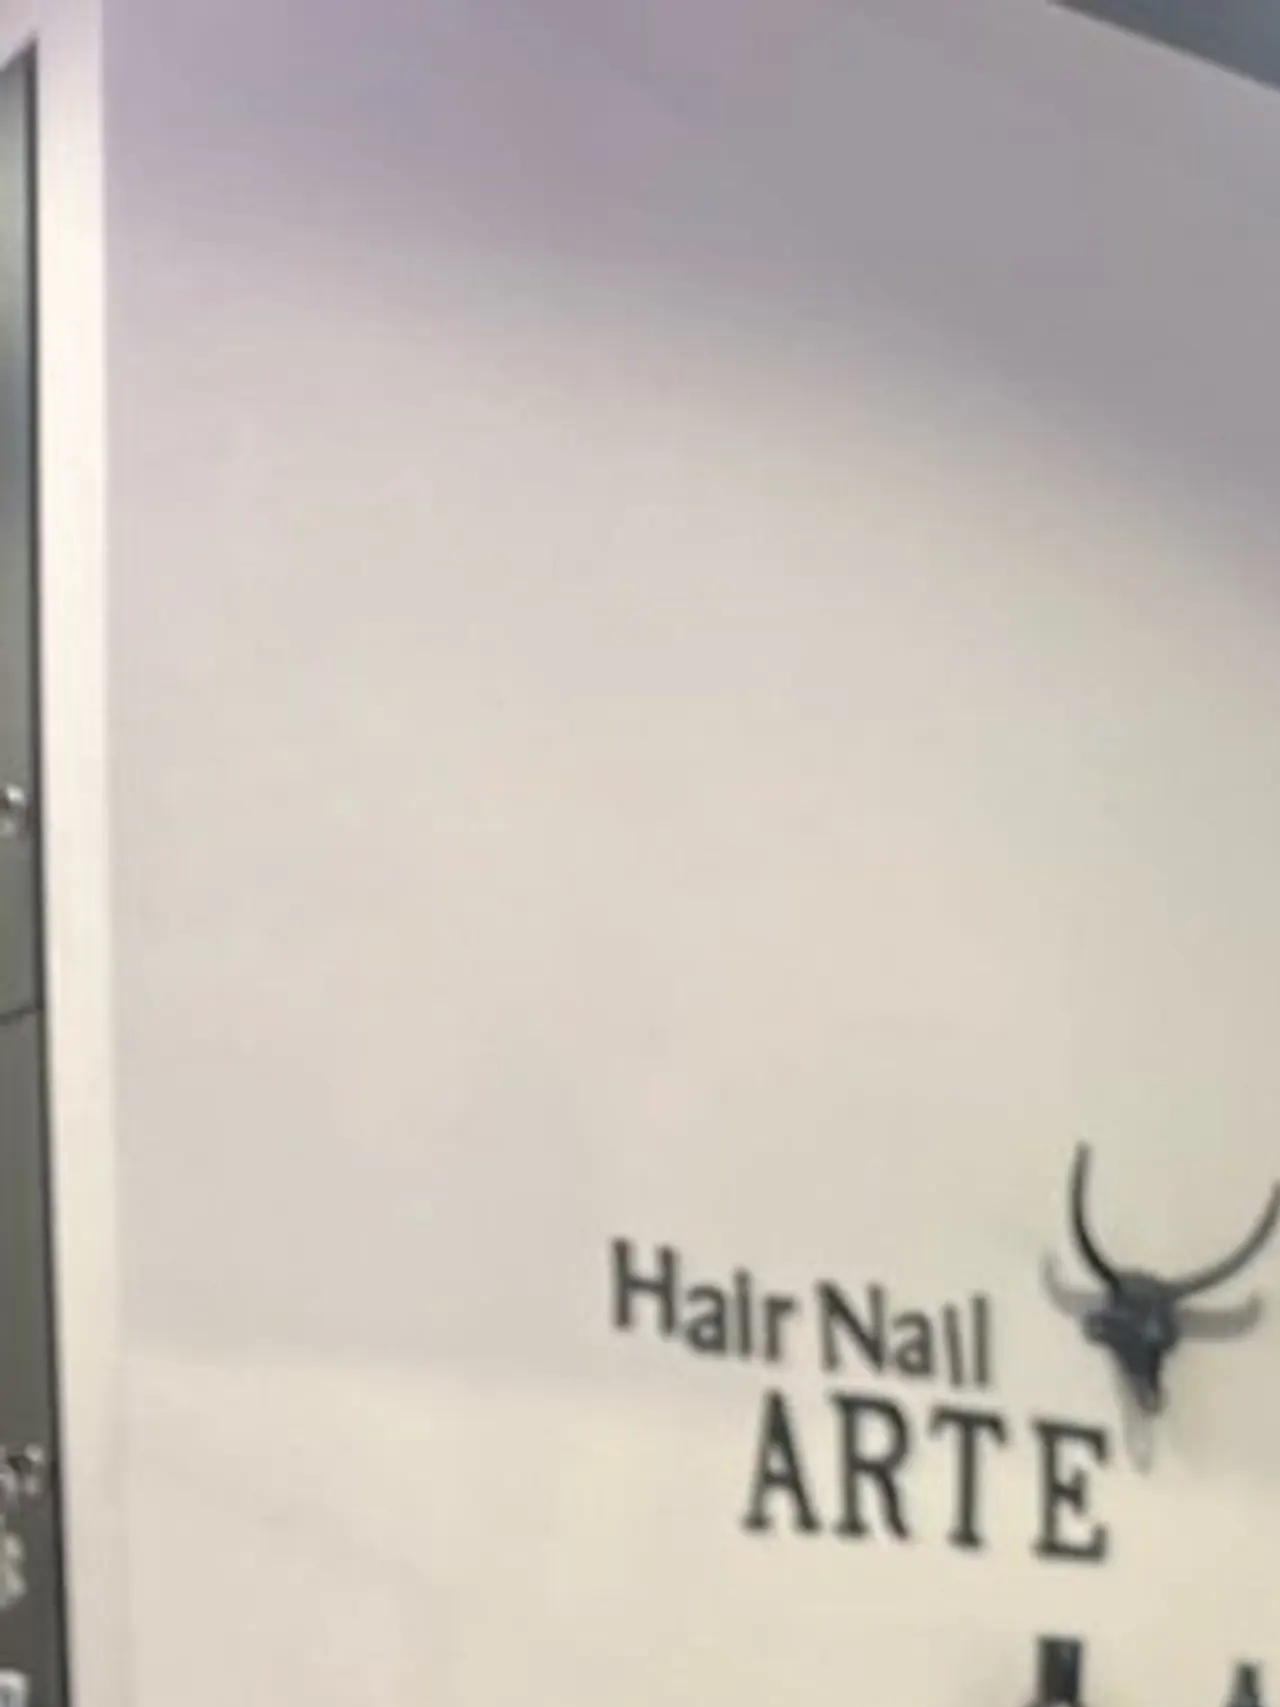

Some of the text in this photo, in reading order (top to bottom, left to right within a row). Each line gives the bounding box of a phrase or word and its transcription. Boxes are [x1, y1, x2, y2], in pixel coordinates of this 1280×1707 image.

[611, 1237, 990, 1389] Hair Nail
[741, 1388, 1109, 1563] ARTE
